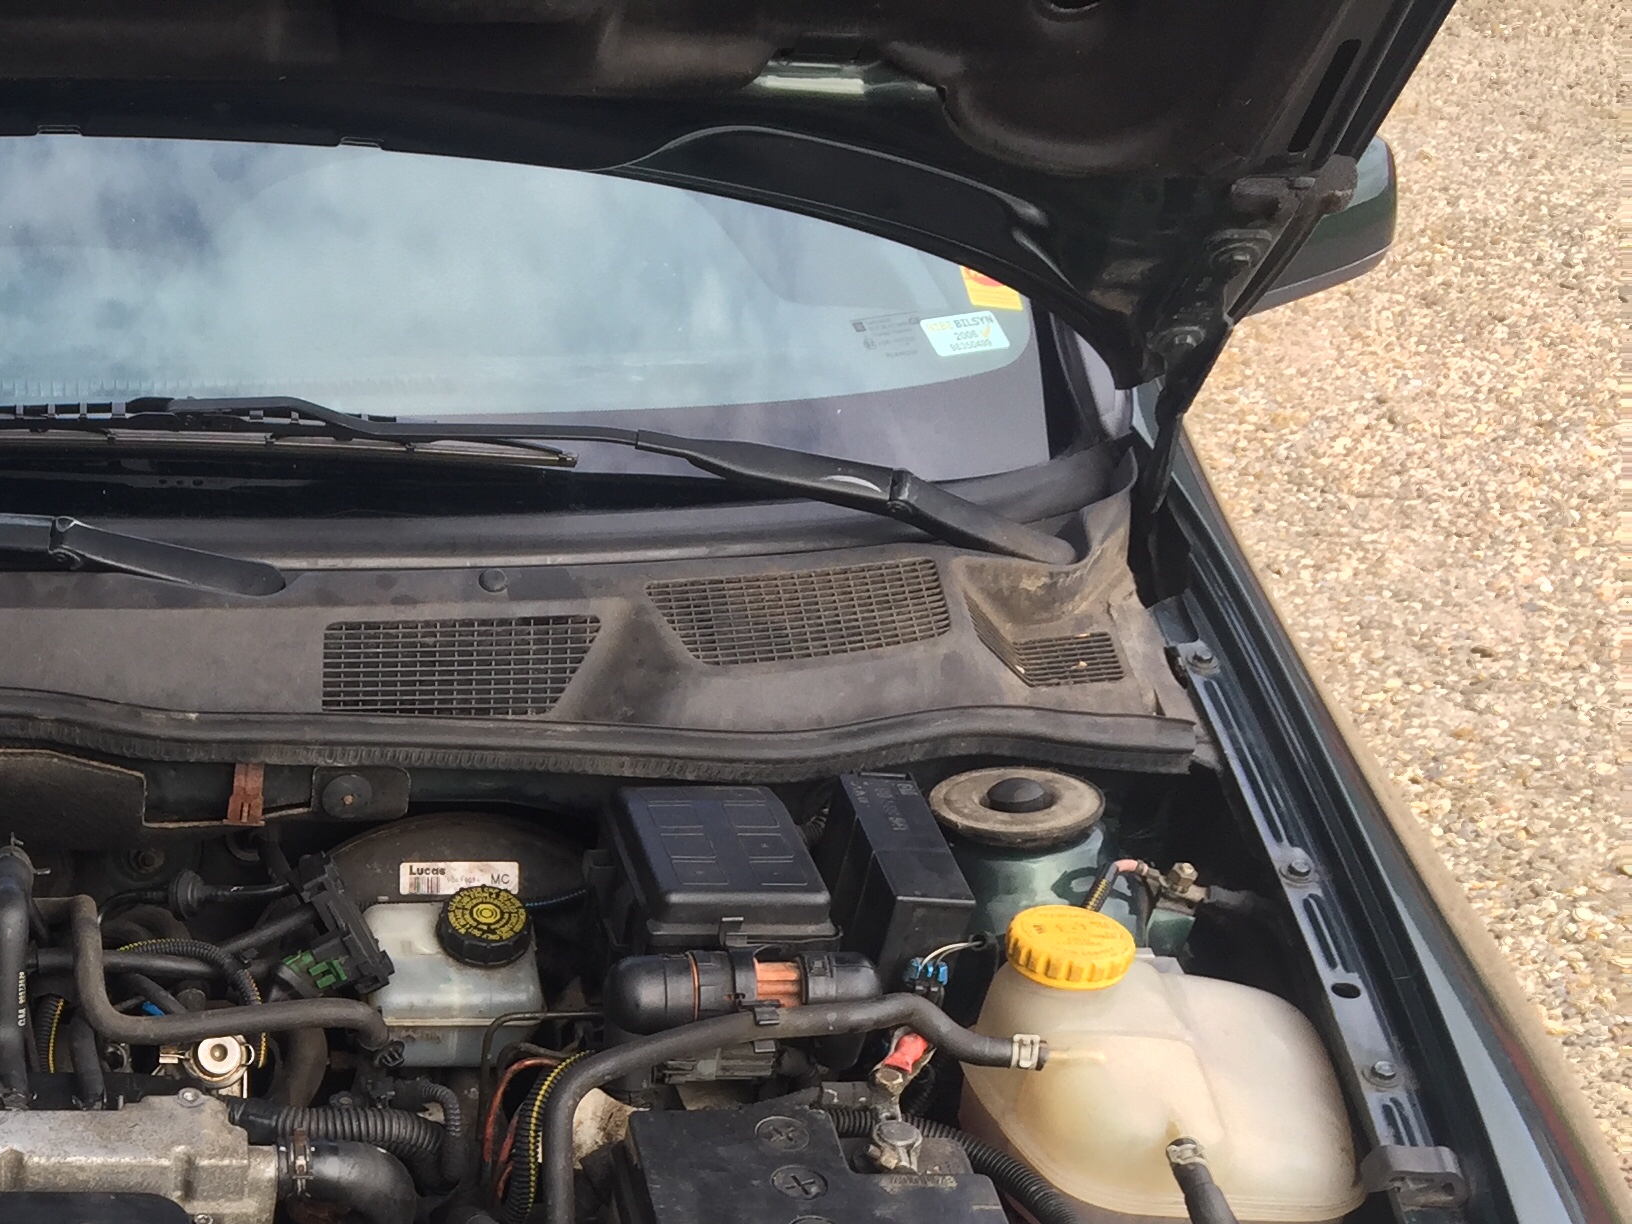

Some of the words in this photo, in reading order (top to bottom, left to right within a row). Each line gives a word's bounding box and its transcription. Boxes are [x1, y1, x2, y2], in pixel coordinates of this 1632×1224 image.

[953, 315, 994, 329] BILSYN
[409, 865, 446, 875] Lucas
[491, 874, 510, 884] MC
